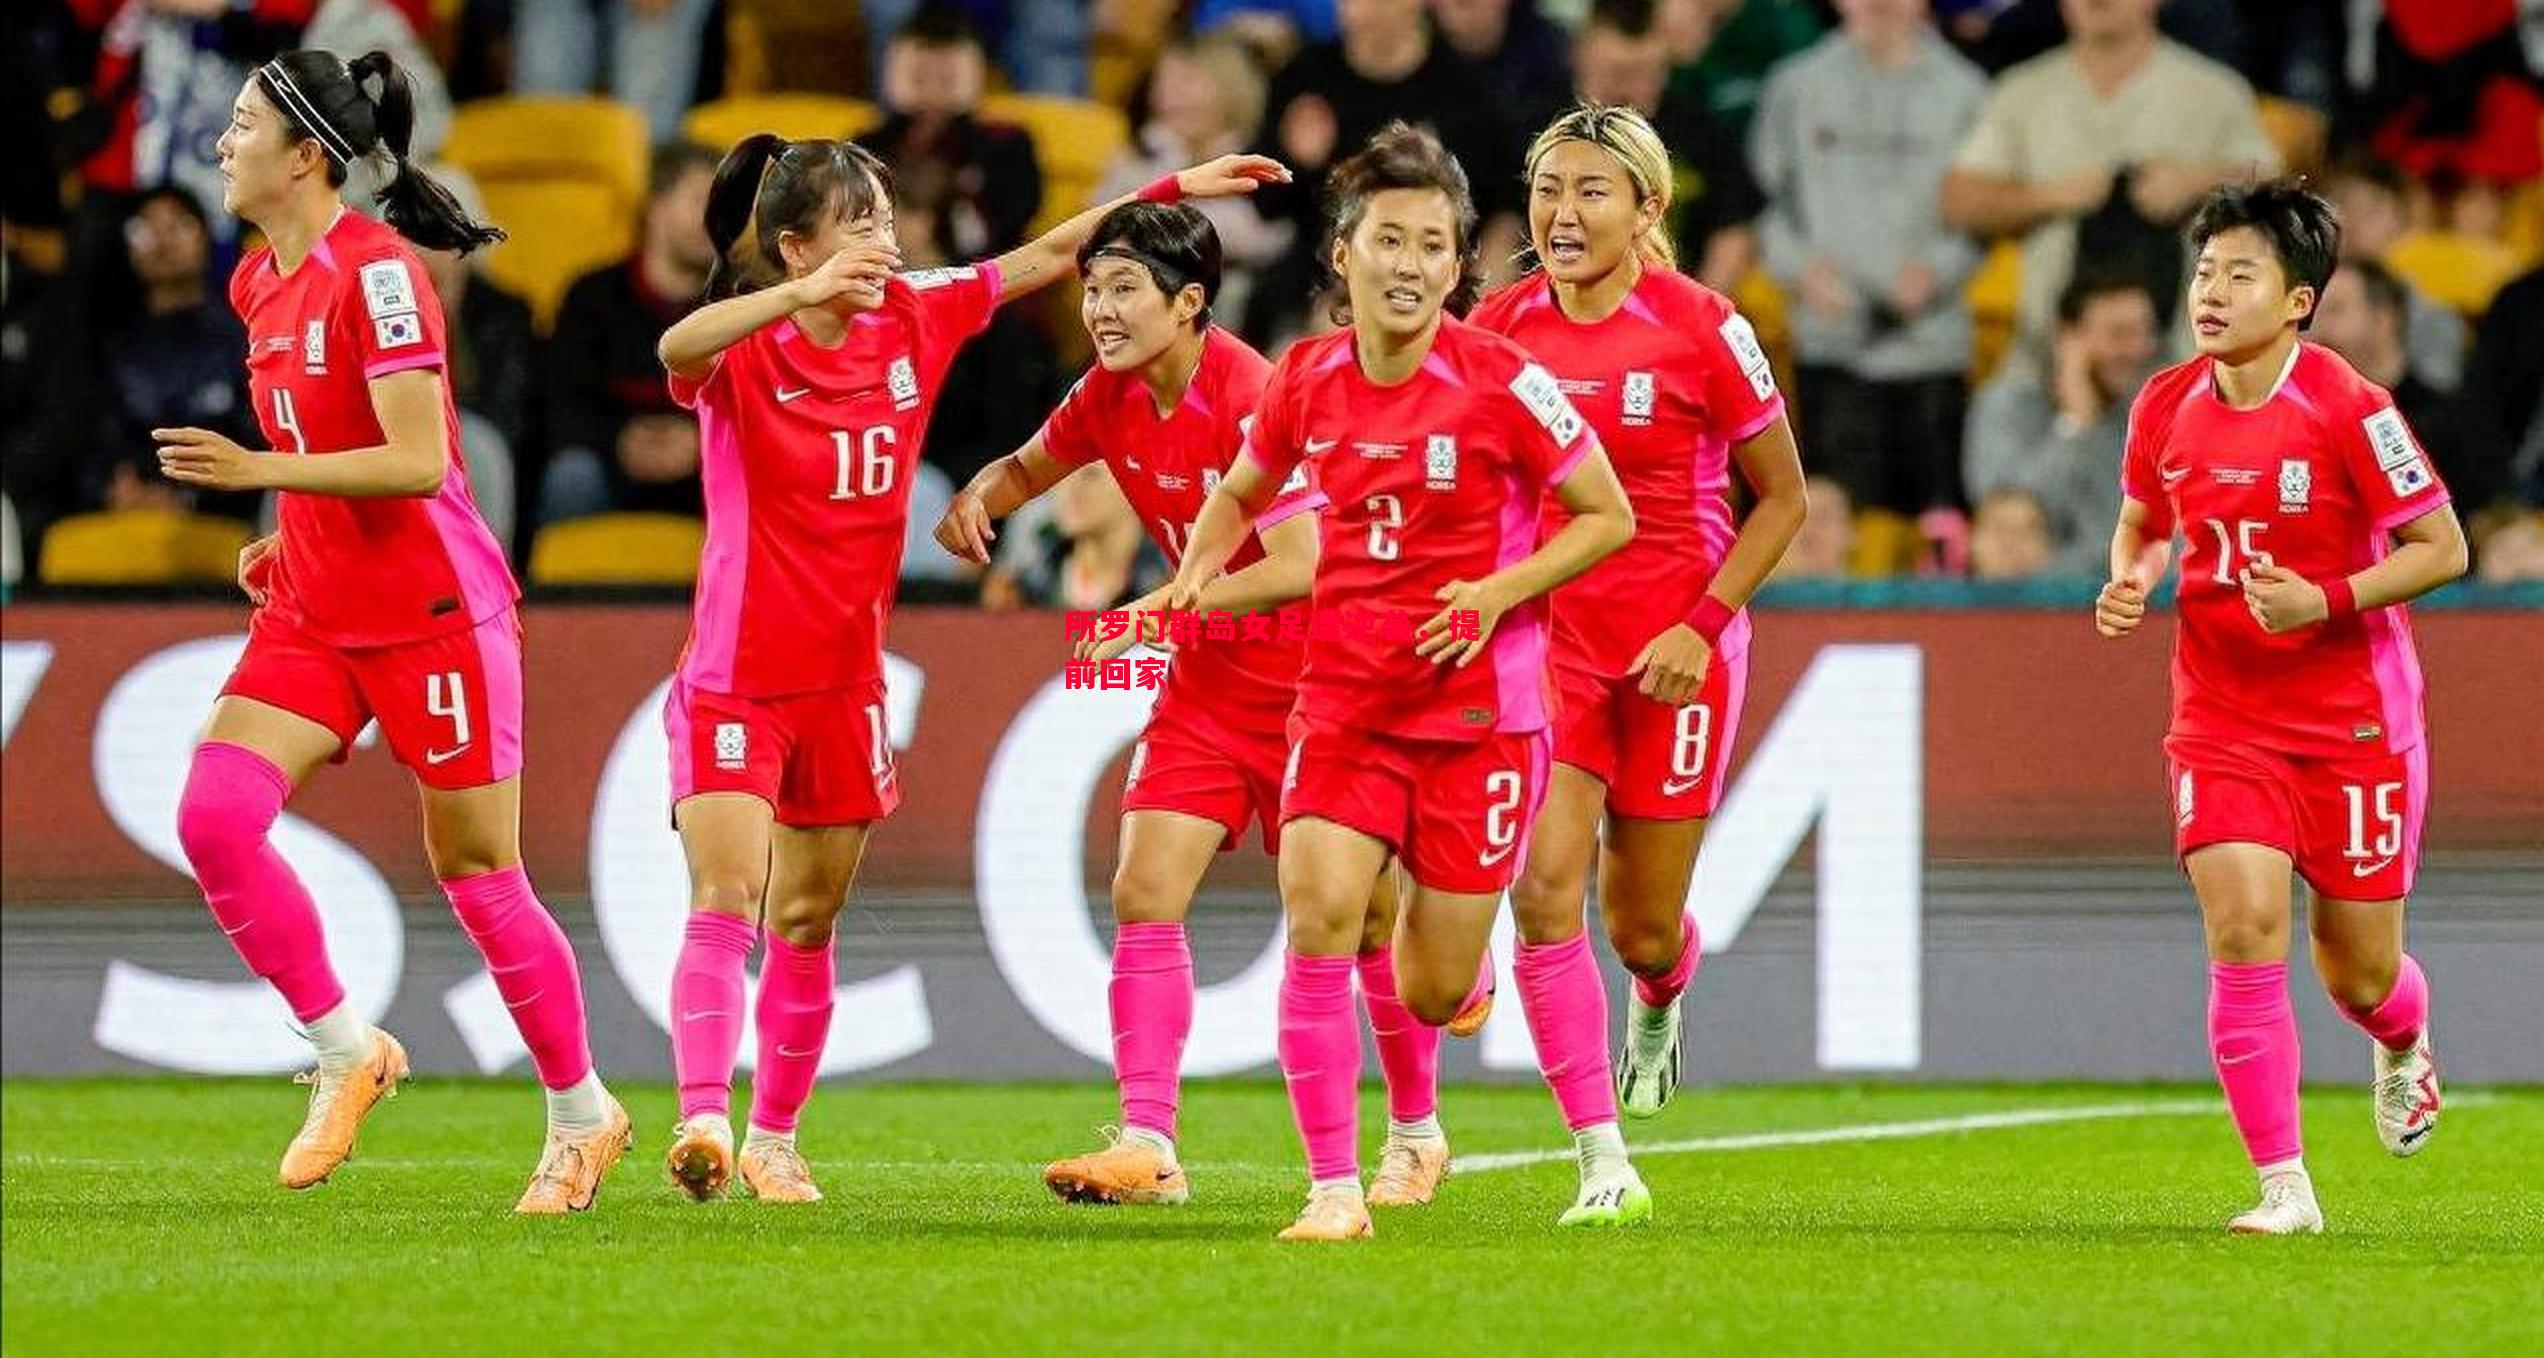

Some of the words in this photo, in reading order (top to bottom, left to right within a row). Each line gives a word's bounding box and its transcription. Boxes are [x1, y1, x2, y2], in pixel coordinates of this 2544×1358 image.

[272, 388, 305, 455] 4
[828, 424, 896, 500] 16
[1366, 495, 1403, 560] 2
[2204, 518, 2274, 585] 15
[427, 671, 470, 744] 4
[1672, 703, 1711, 776] 8
[1486, 770, 1521, 846] 2
[2342, 782, 2402, 858] 15
